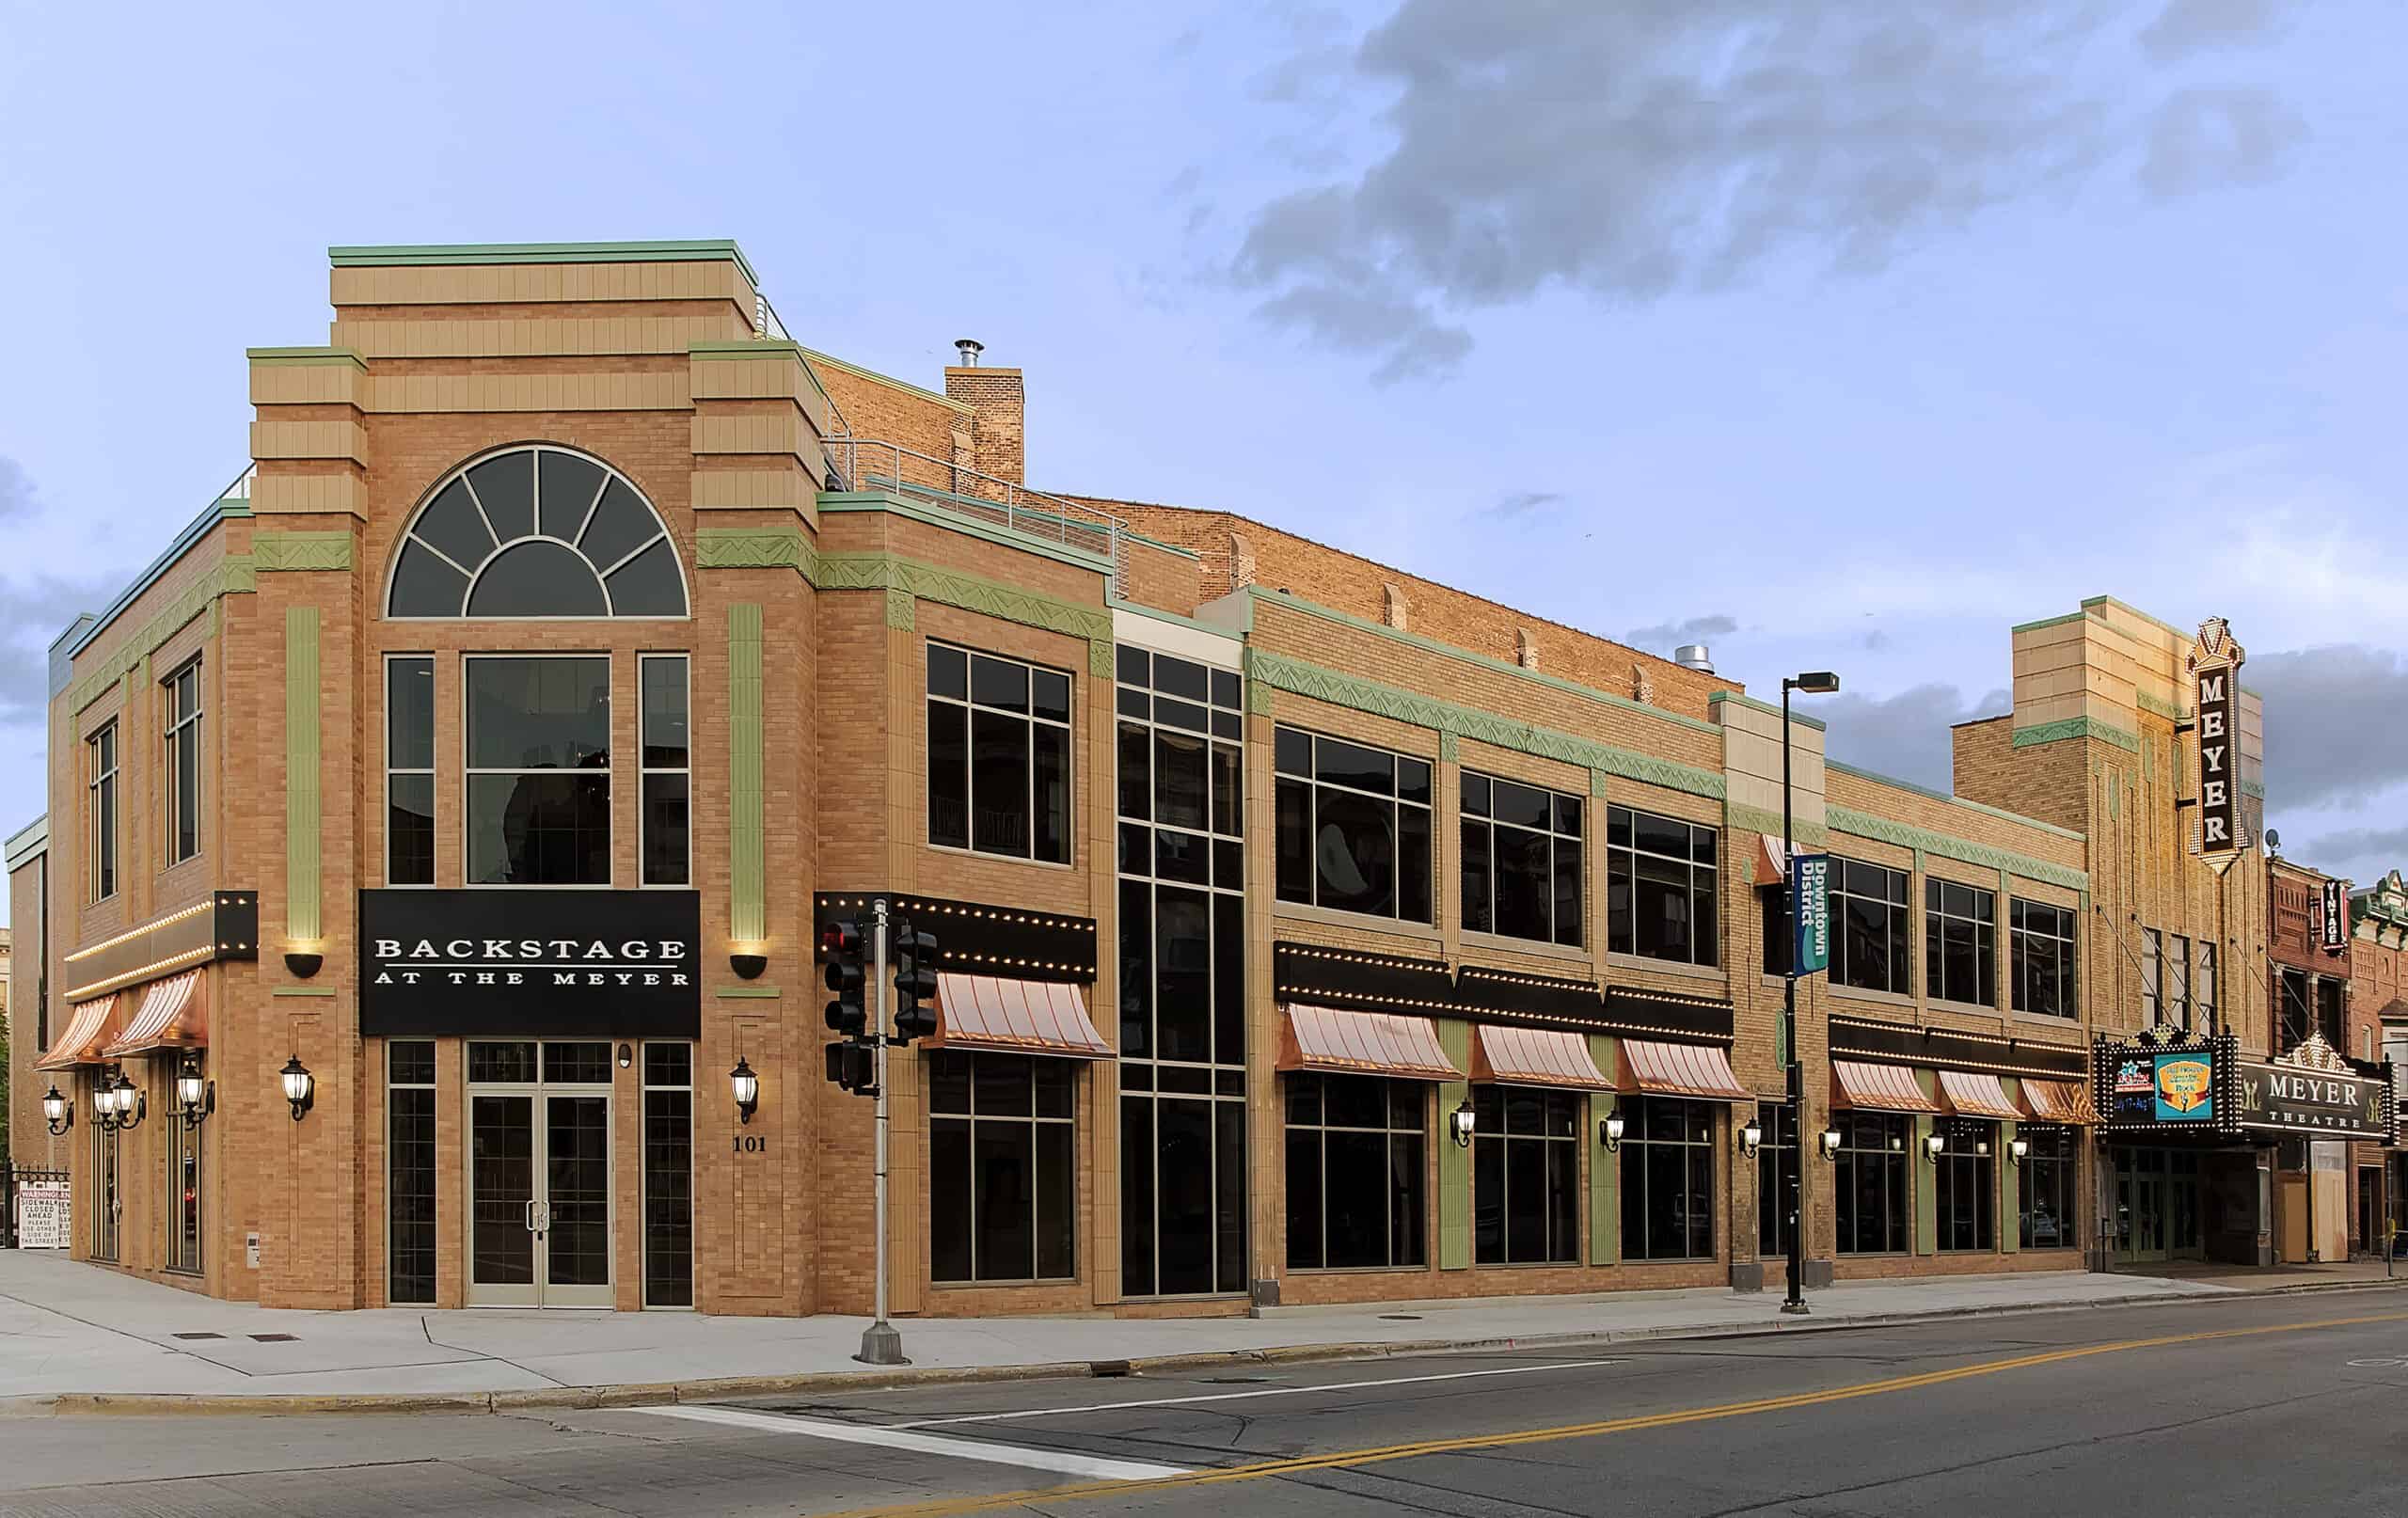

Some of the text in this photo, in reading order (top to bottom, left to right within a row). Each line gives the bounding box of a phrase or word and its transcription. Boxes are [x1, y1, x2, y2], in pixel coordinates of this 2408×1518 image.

[2200, 675, 2229, 843] MEYER
[1801, 862, 1814, 926] District
[1815, 862, 1827, 957] Downtown
[2327, 882, 2337, 943] VINTAGE
[375, 940, 686, 959] BACKSTAGE
[374, 972, 689, 987] AT THE MEYER
[2269, 1074, 2358, 1106] MEYER
[2269, 1112, 2360, 1129] THEATRE
[733, 1136, 766, 1152] 101
